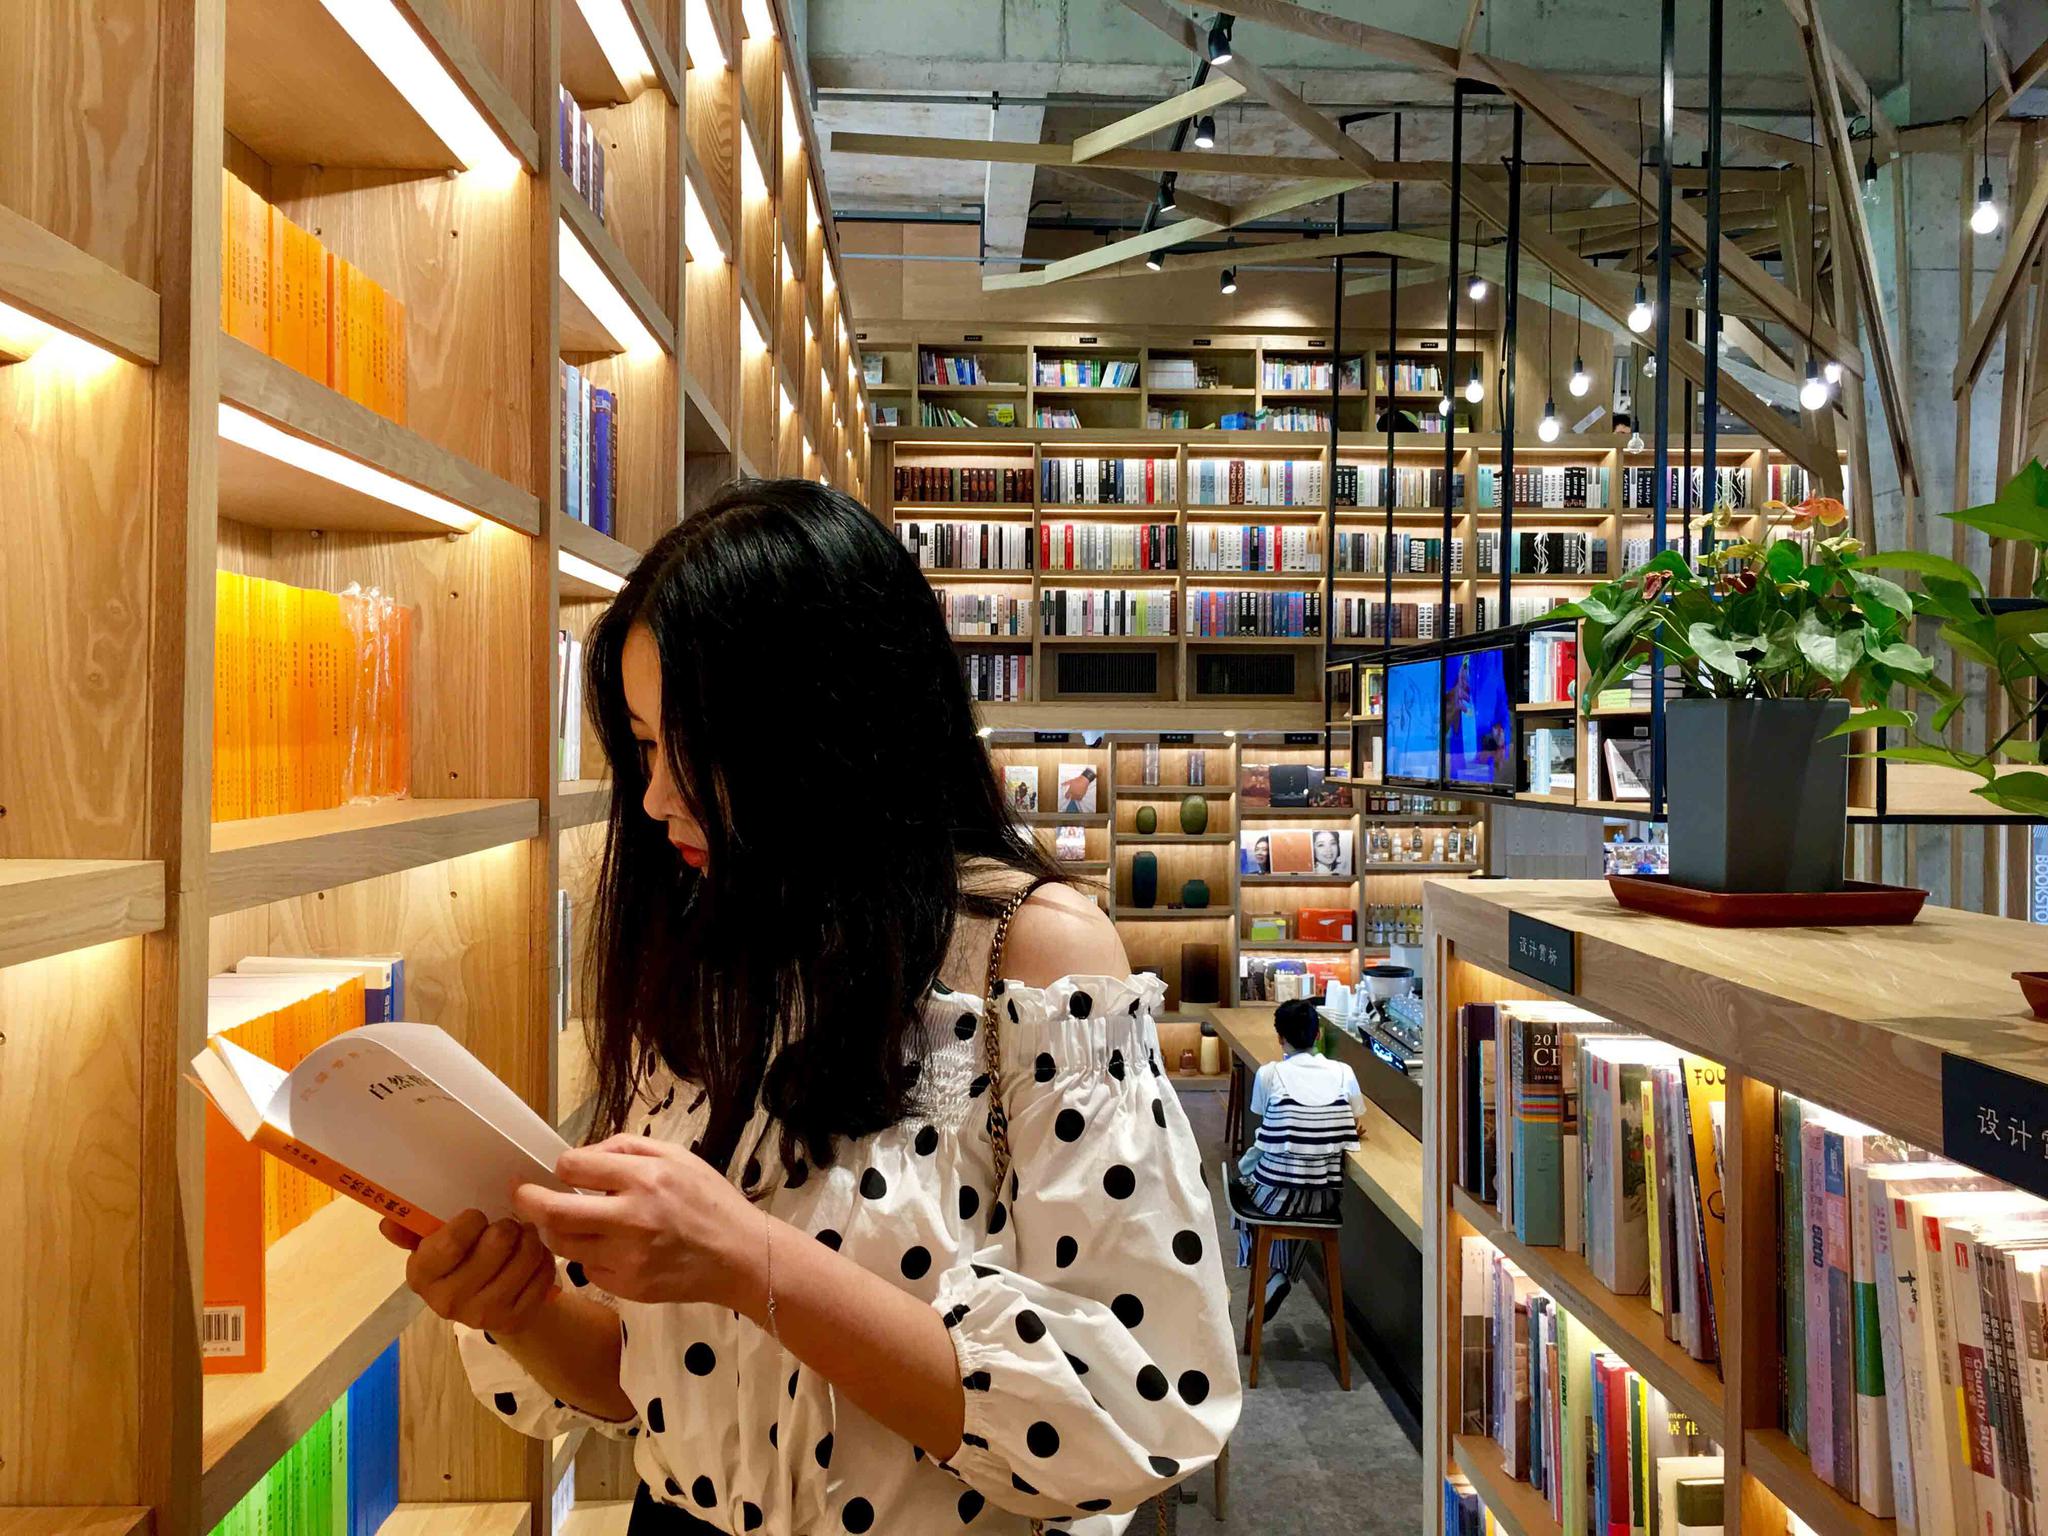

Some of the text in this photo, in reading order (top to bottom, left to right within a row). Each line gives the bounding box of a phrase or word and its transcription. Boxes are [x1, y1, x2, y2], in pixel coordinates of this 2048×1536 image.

[1534, 1034, 1559, 1046] 201
[1533, 1048, 1560, 1066] CH
[1694, 1068, 1726, 1086] FOU
[1973, 1358, 1994, 1465] Country Style
